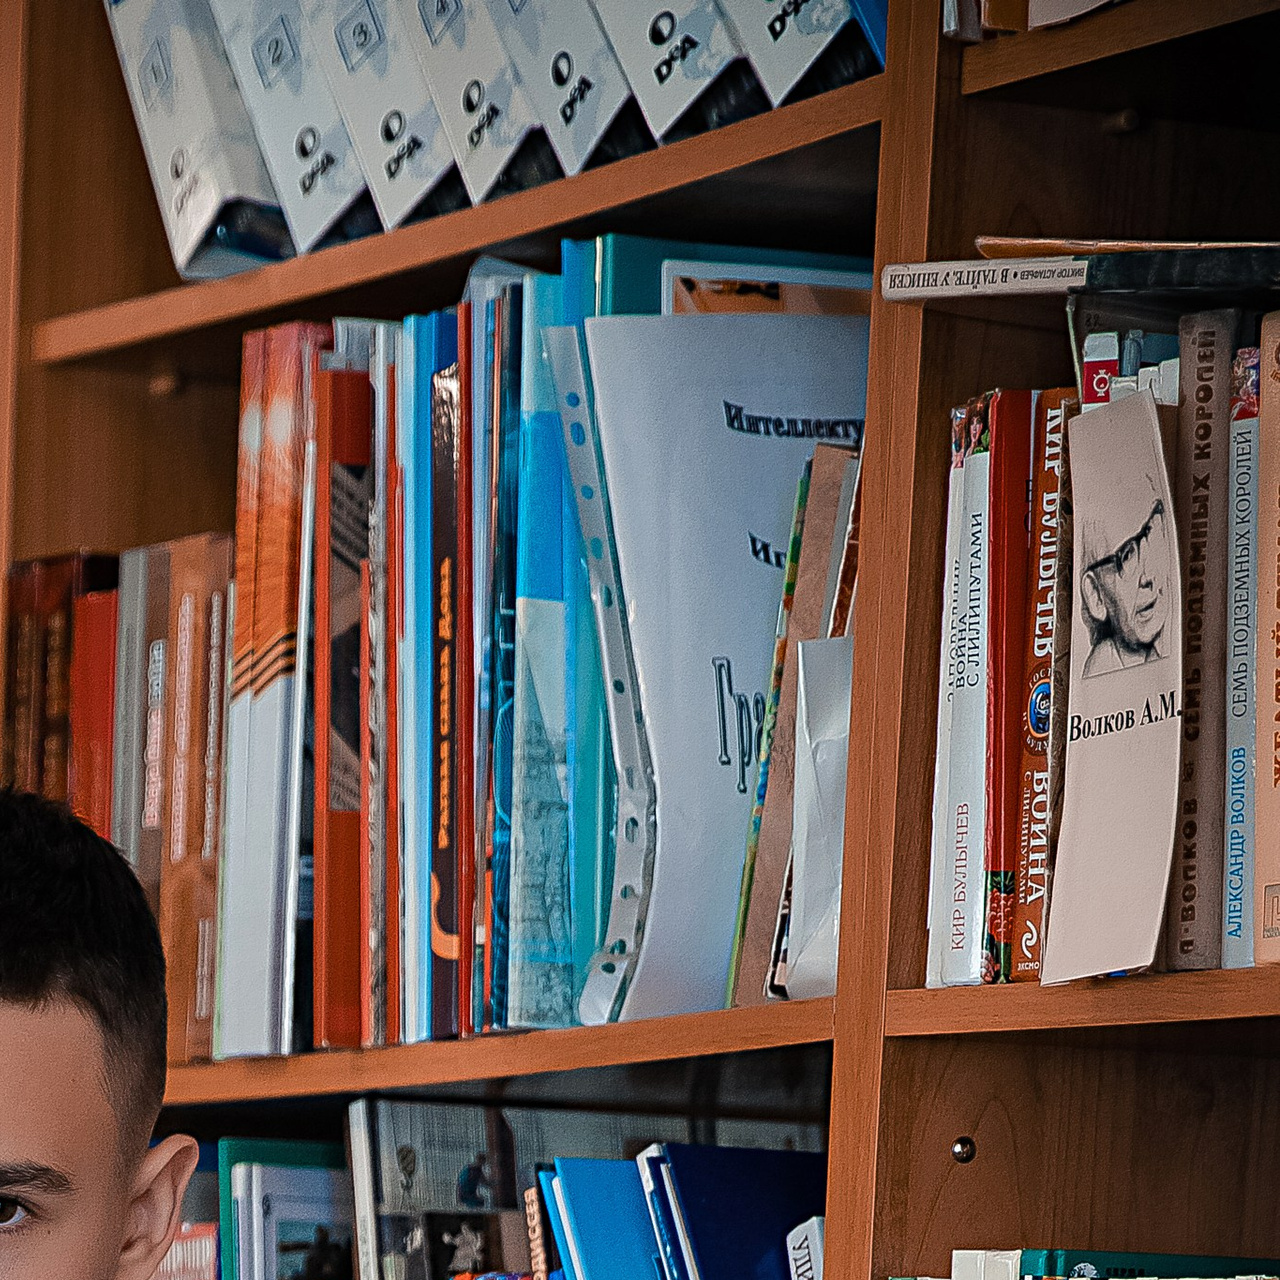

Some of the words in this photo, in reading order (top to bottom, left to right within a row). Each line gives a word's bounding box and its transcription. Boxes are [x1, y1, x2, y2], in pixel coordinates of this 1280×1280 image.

[889, 271, 939, 290] ЕНИСЕЯ
[941, 272, 951, 287] У
[953, 269, 998, 289] ТАЙГЕ,
[1000, 268, 1010, 284] В
[1056, 267, 1085, 278] ВИКТОР
[1192, 328, 1217, 462] КОРОЛЕЙ
[1234, 428, 1253, 523] КОРОЛЕЙ
[967, 512, 984, 669] ЛИЛИПУТАМИ
[1186, 472, 1212, 654] ПОДЗЕМНЫХ
[1232, 526, 1251, 659] ПОДЗЕМНЫХ
[955, 612, 969, 689] ВОЙНА
[966, 672, 981, 688] С
[1068, 707, 1137, 743] Волков
[1139, 689, 1183, 727] А.М.
[1232, 662, 1249, 718] СЕМЬ
[1230, 746, 1247, 825] ВОЛКОВ
[953, 802, 970, 902] БУЛЫЧЕВ
[1018, 789, 1032, 905] ЛИЛИПУТАМИ
[1227, 829, 1247, 939] АЛЕКСАНДР
[951, 909, 968, 952] КИР
